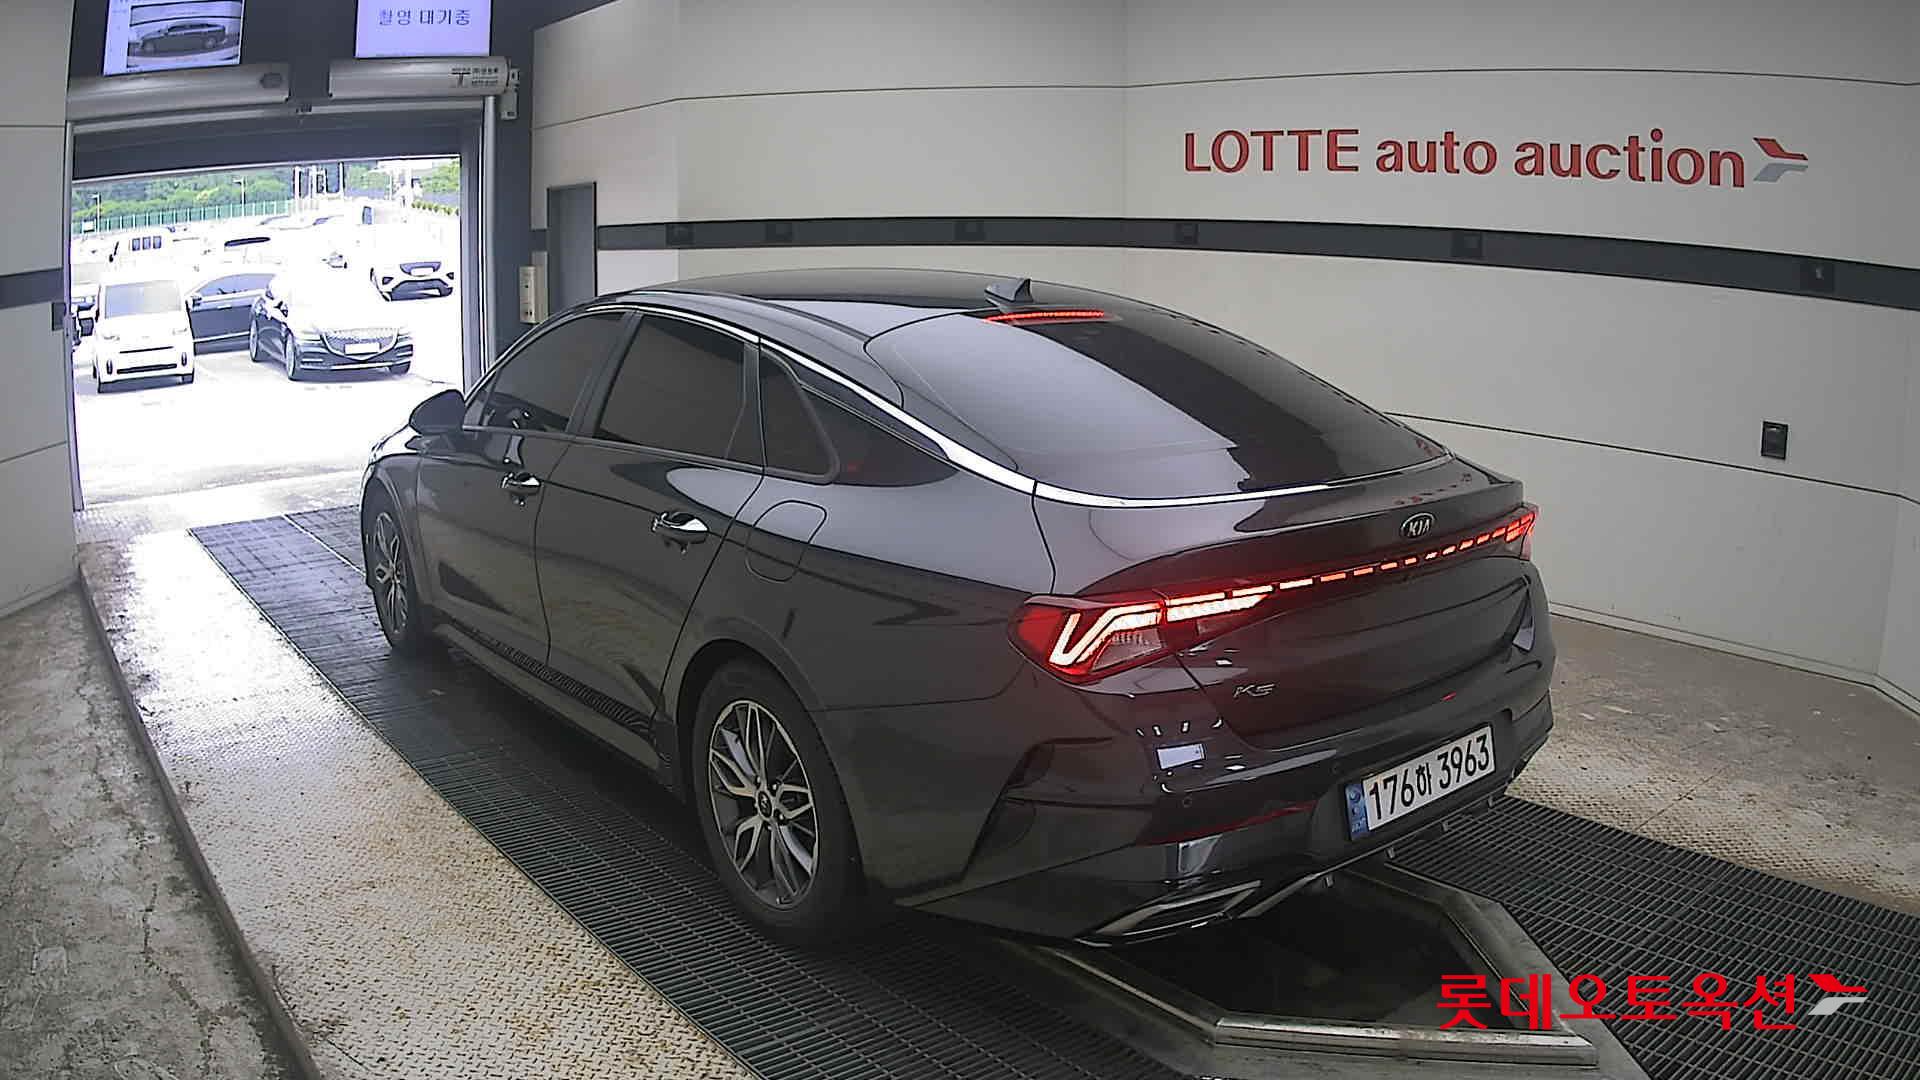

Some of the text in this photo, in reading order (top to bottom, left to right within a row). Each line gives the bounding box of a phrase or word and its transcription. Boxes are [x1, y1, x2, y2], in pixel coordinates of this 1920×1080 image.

[419, 9, 471, 26] 대기중
[1184, 128, 1745, 188] LOTTE auto auction
[1407, 519, 1430, 537] KIA
[1233, 683, 1275, 698] K5
[1369, 734, 1490, 820] 176하 3963
